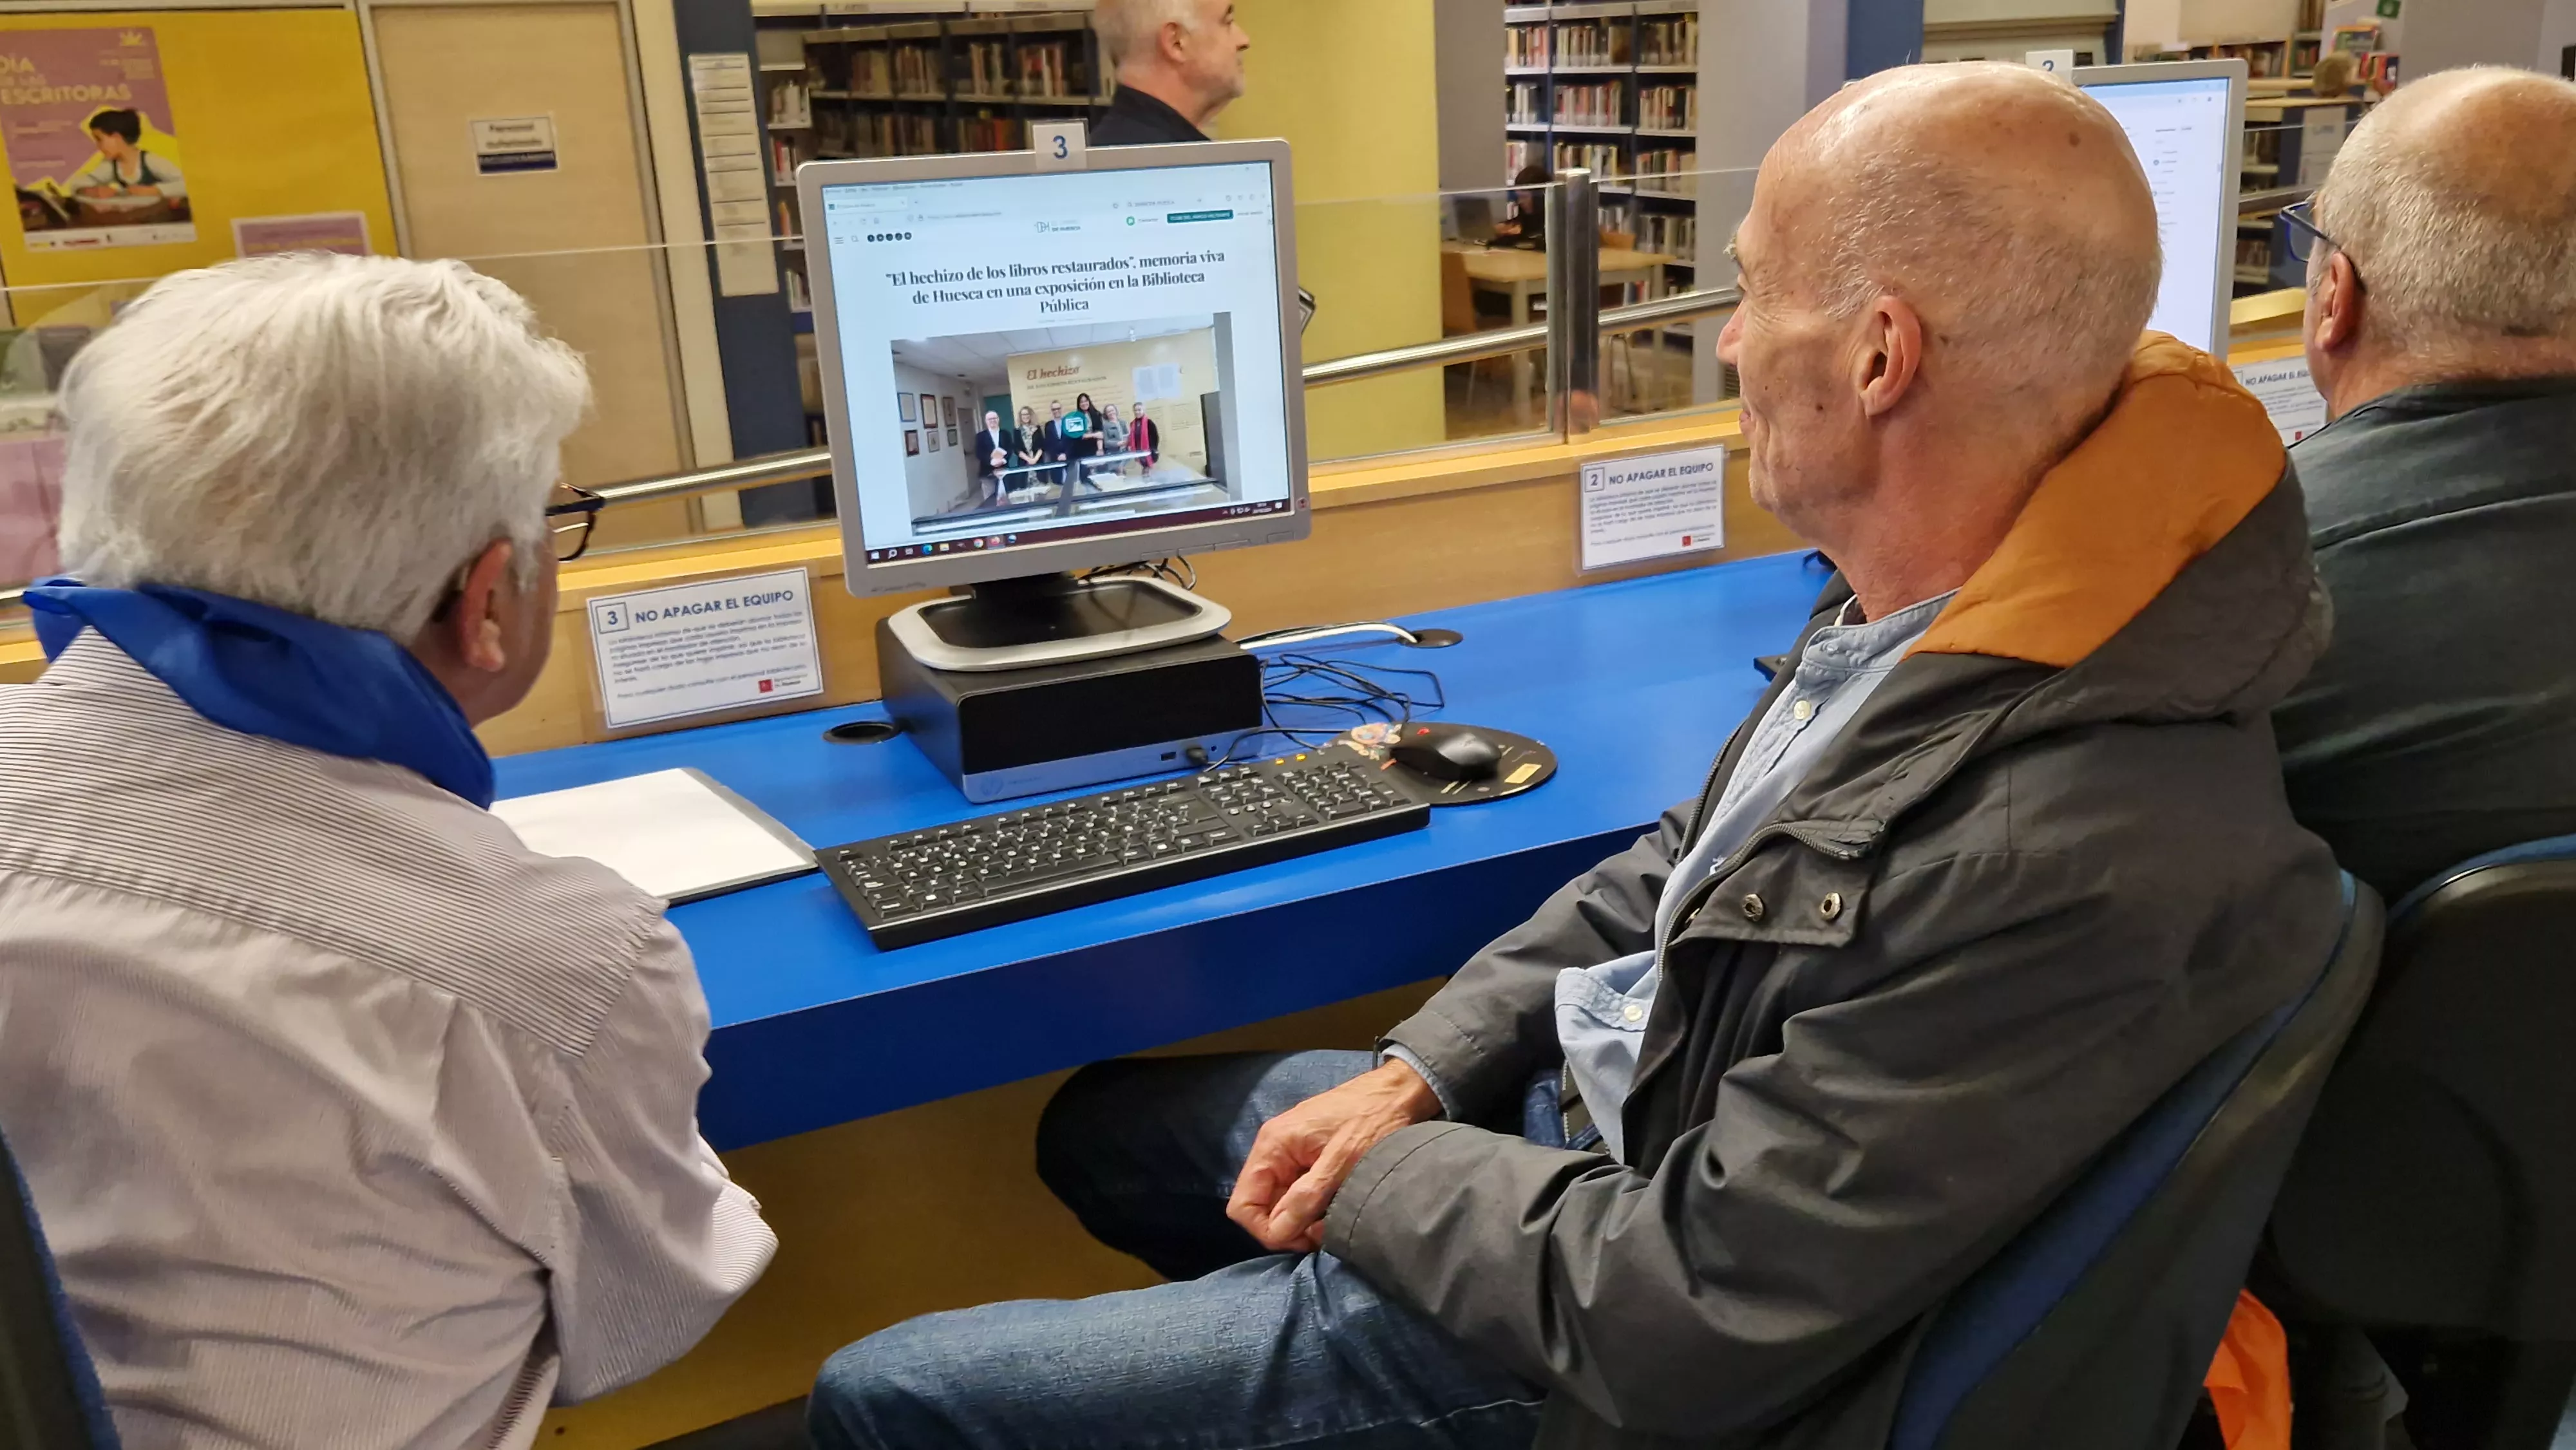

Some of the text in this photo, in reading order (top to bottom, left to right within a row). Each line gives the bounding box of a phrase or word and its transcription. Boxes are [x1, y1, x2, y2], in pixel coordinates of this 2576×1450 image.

[1053, 135, 1068, 159] 3
[909, 268, 964, 285] hechizo
[967, 267, 983, 281] de
[986, 265, 1007, 279] los
[1009, 263, 1048, 278] libros
[1139, 251, 1198, 268] memoria
[1200, 250, 1226, 263] viva
[913, 271, 1206, 305] de Huesca en una exposición en la Biblioteca
[1040, 298, 1090, 314] Pública
[2245, 377, 2257, 386] NO
[1591, 462, 1714, 486] 2 NO APAGAR EL EQUIPO
[607, 590, 793, 625] 3 NO APAGAR EL EQUIPO
